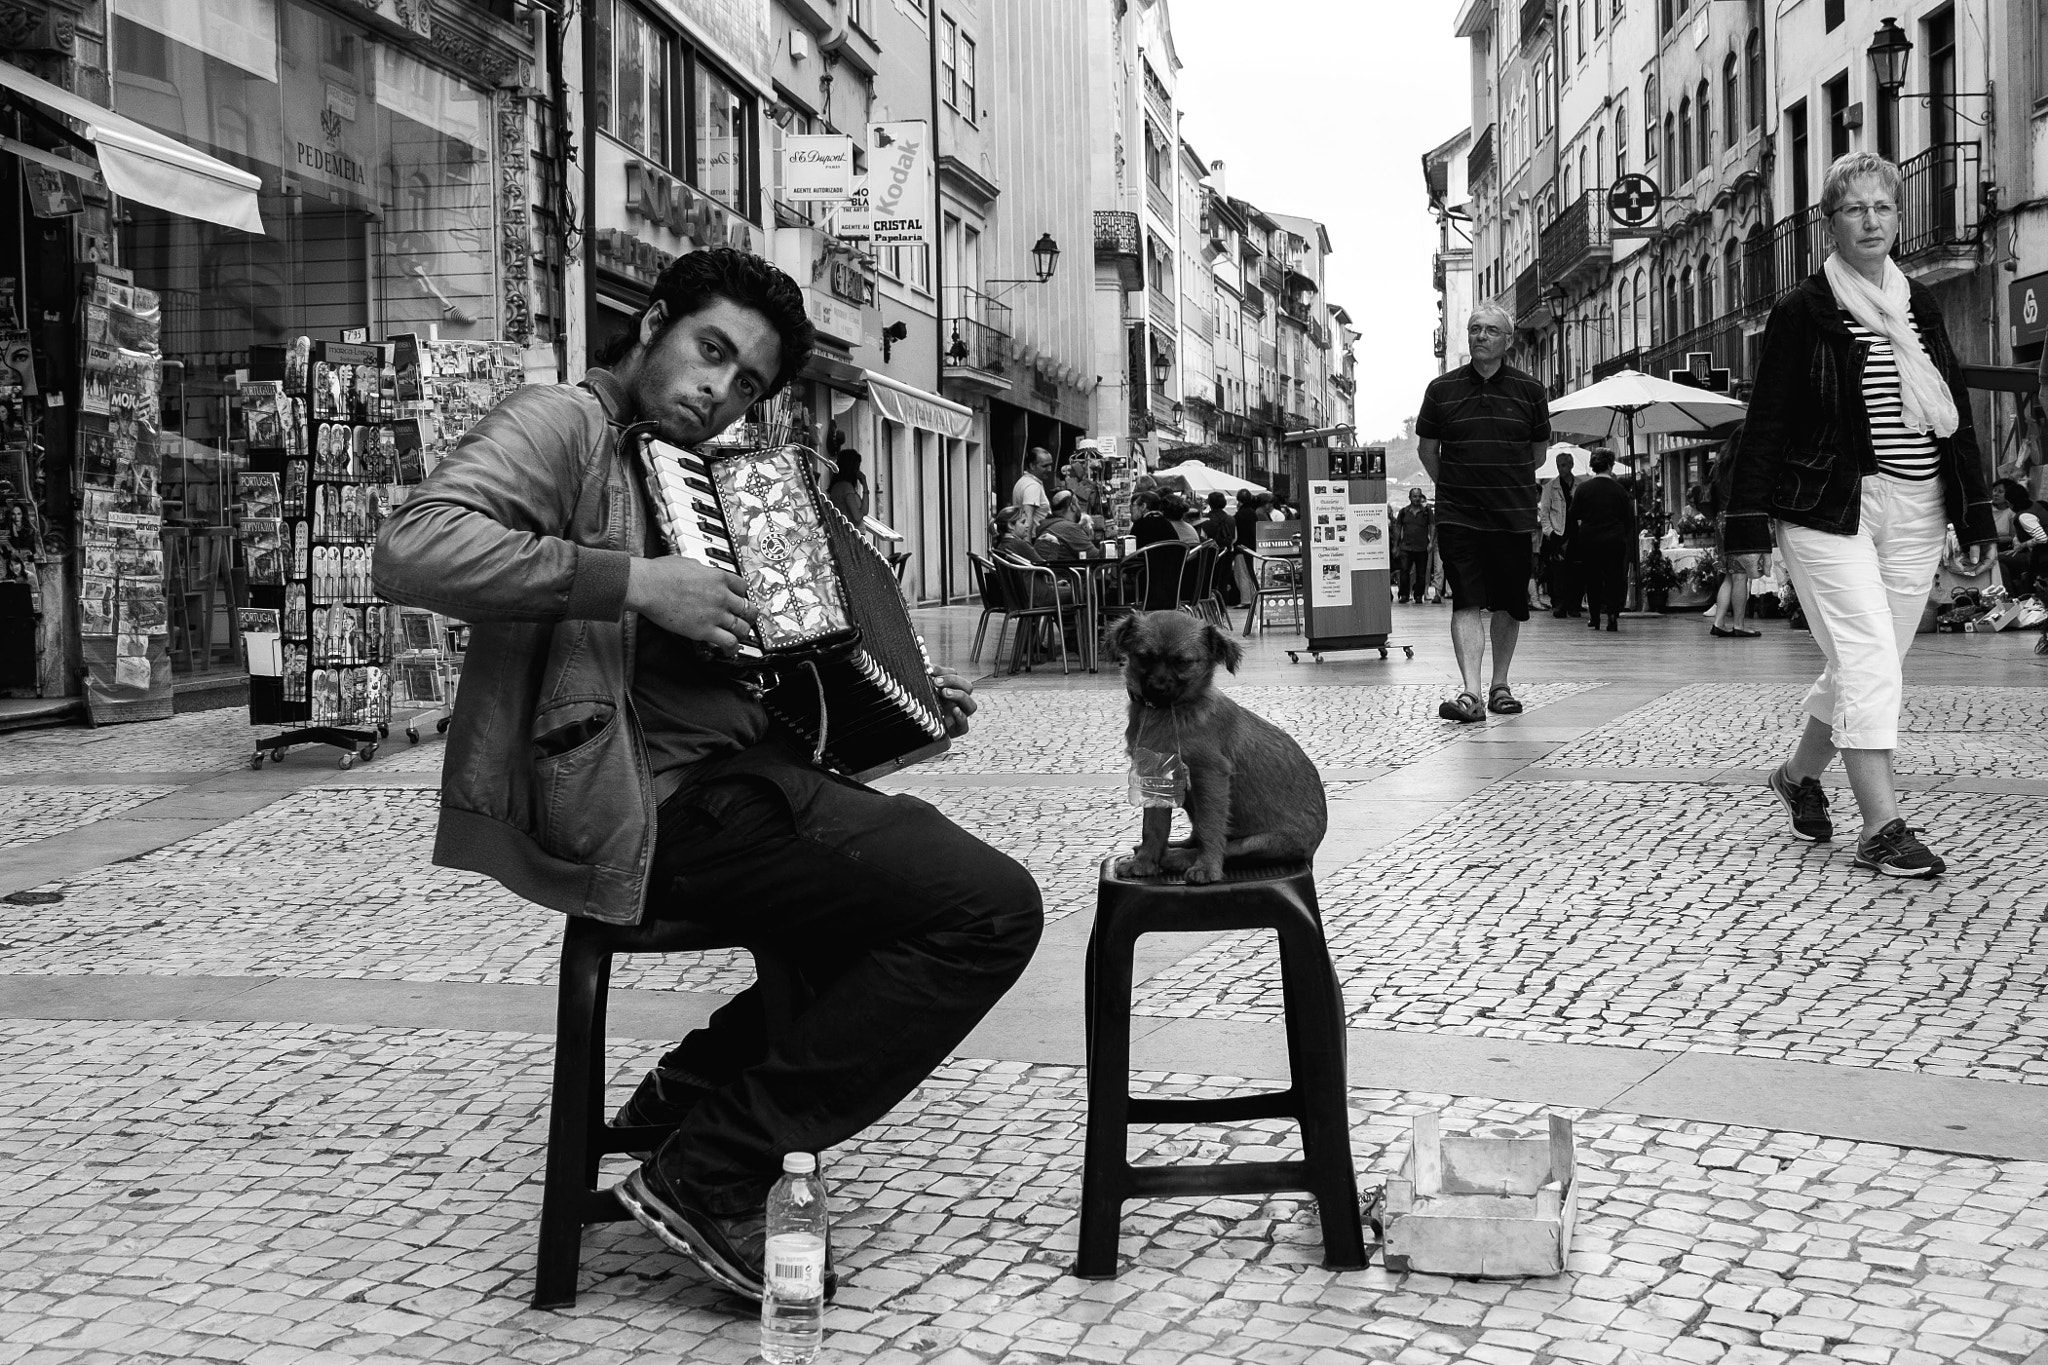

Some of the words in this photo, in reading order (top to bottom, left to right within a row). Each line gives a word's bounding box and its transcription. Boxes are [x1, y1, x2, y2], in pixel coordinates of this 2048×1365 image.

[297, 141, 365, 185] PEDEMEIA
[807, 149, 848, 165] Dupont
[875, 139, 921, 217] Kodak
[873, 219, 922, 231] CRISTAL
[875, 234, 922, 242] Papelaria
[240, 476, 275, 487] PORTUGAL
[240, 611, 275, 623] PORTUGAL
